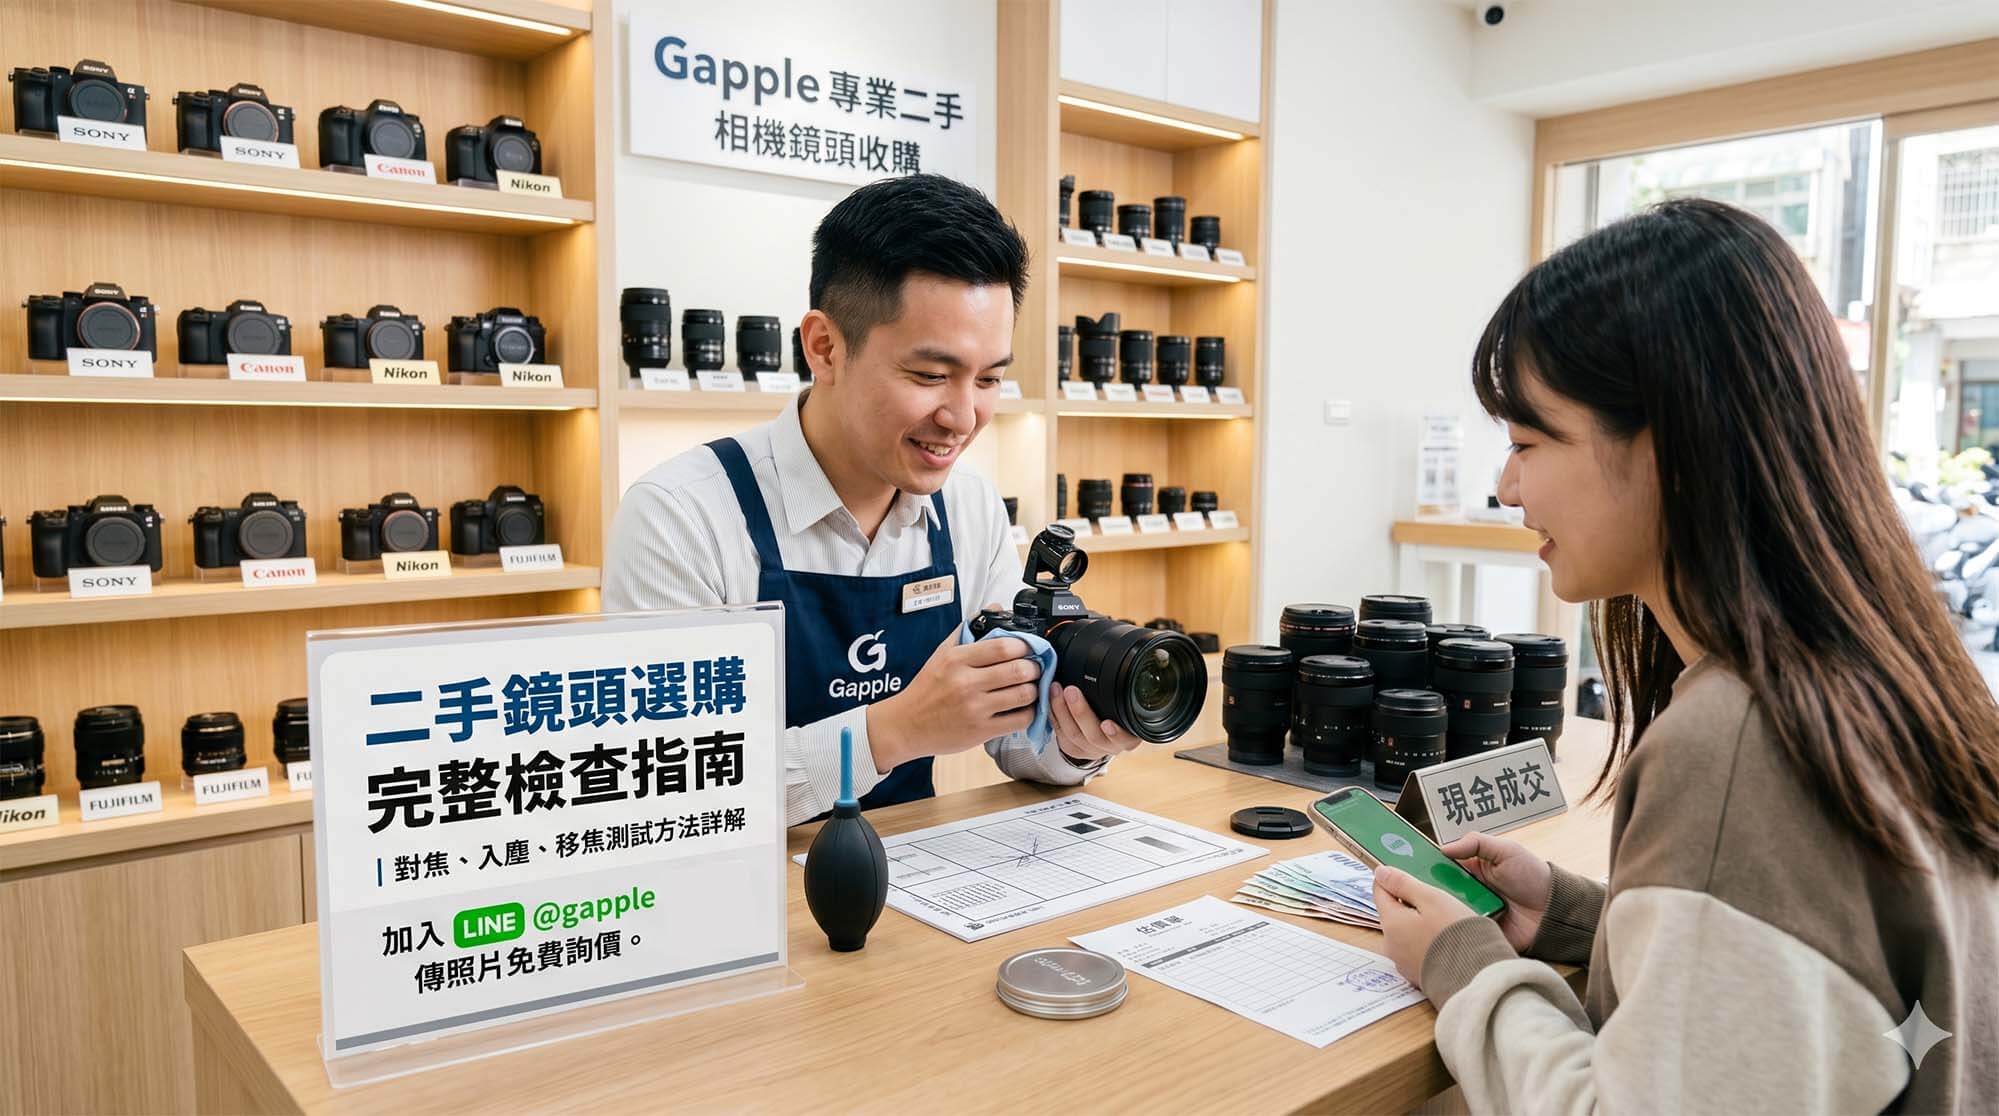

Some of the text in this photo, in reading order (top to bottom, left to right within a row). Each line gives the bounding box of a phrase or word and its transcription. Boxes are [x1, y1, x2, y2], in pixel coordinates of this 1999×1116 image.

[654, 36, 964, 129] Gapple 專業二手
[73, 127, 131, 142] SONY
[715, 110, 921, 174] 相機鏡頭收購
[234, 145, 286, 160] SONY
[376, 162, 426, 177] Canon
[510, 178, 551, 193] Nikon
[82, 358, 138, 369] SONY
[239, 361, 295, 375] Canon
[384, 367, 428, 380] Nikon
[512, 370, 552, 383] Nikon
[396, 560, 439, 573] Nikon
[509, 553, 557, 565] FUJIFILM
[252, 566, 306, 580] Canon
[82, 575, 137, 589] SONY
[829, 673, 902, 702] Gapple
[365, 656, 747, 746] 二手鏡頭選購
[202, 778, 262, 796] FUJIFILM
[367, 731, 746, 834] 完整檢查指南
[1437, 761, 1552, 826] 現金成交
[89, 793, 153, 812] FUJIFILM
[394, 808, 746, 883] 對焦、入塵、移焦測試方法詳解
[382, 887, 656, 956] 加入 LINE @gapple
[414, 930, 642, 994] 傳照片免費詢價。
